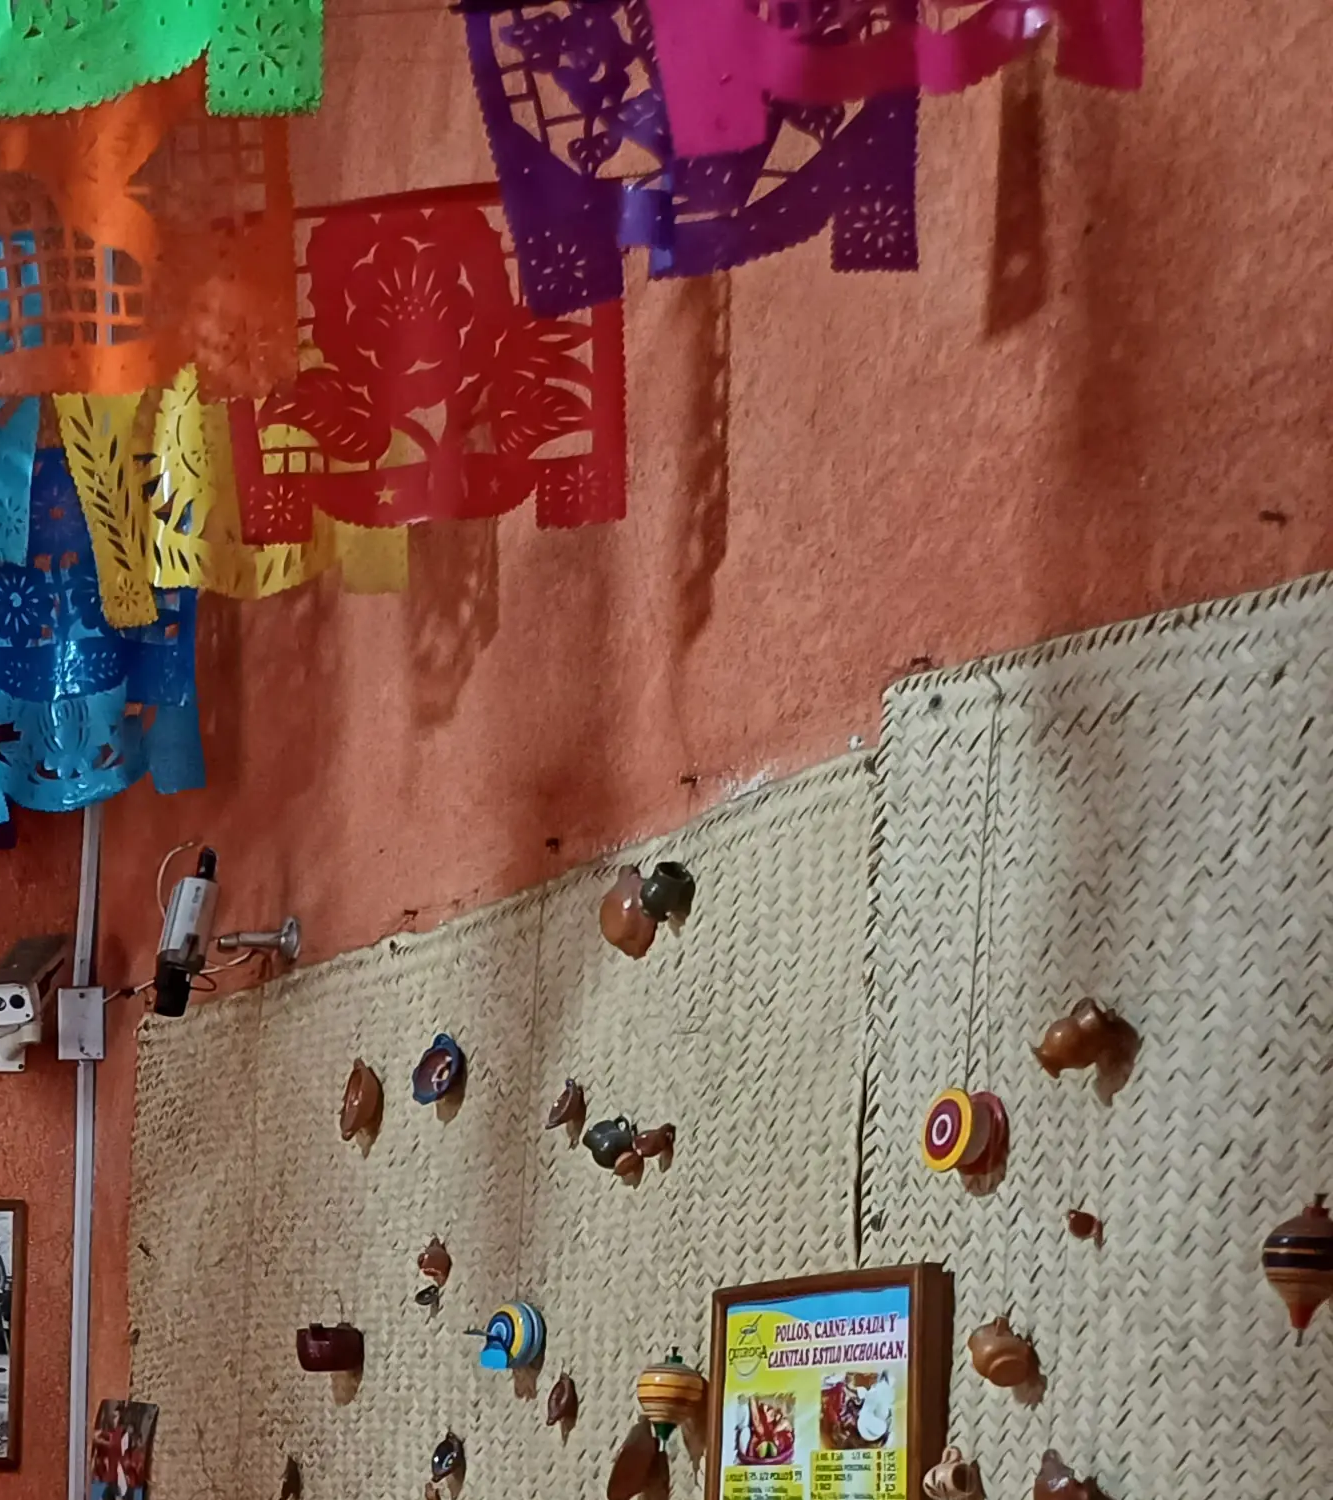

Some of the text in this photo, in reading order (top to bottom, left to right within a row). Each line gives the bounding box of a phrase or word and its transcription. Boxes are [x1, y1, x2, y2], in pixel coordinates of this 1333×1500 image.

[774, 1313, 898, 1343] POLLOS, CARNE ASADA Y
[768, 1347, 810, 1369] CARNITAS
[811, 1345, 843, 1366] ESTILO
